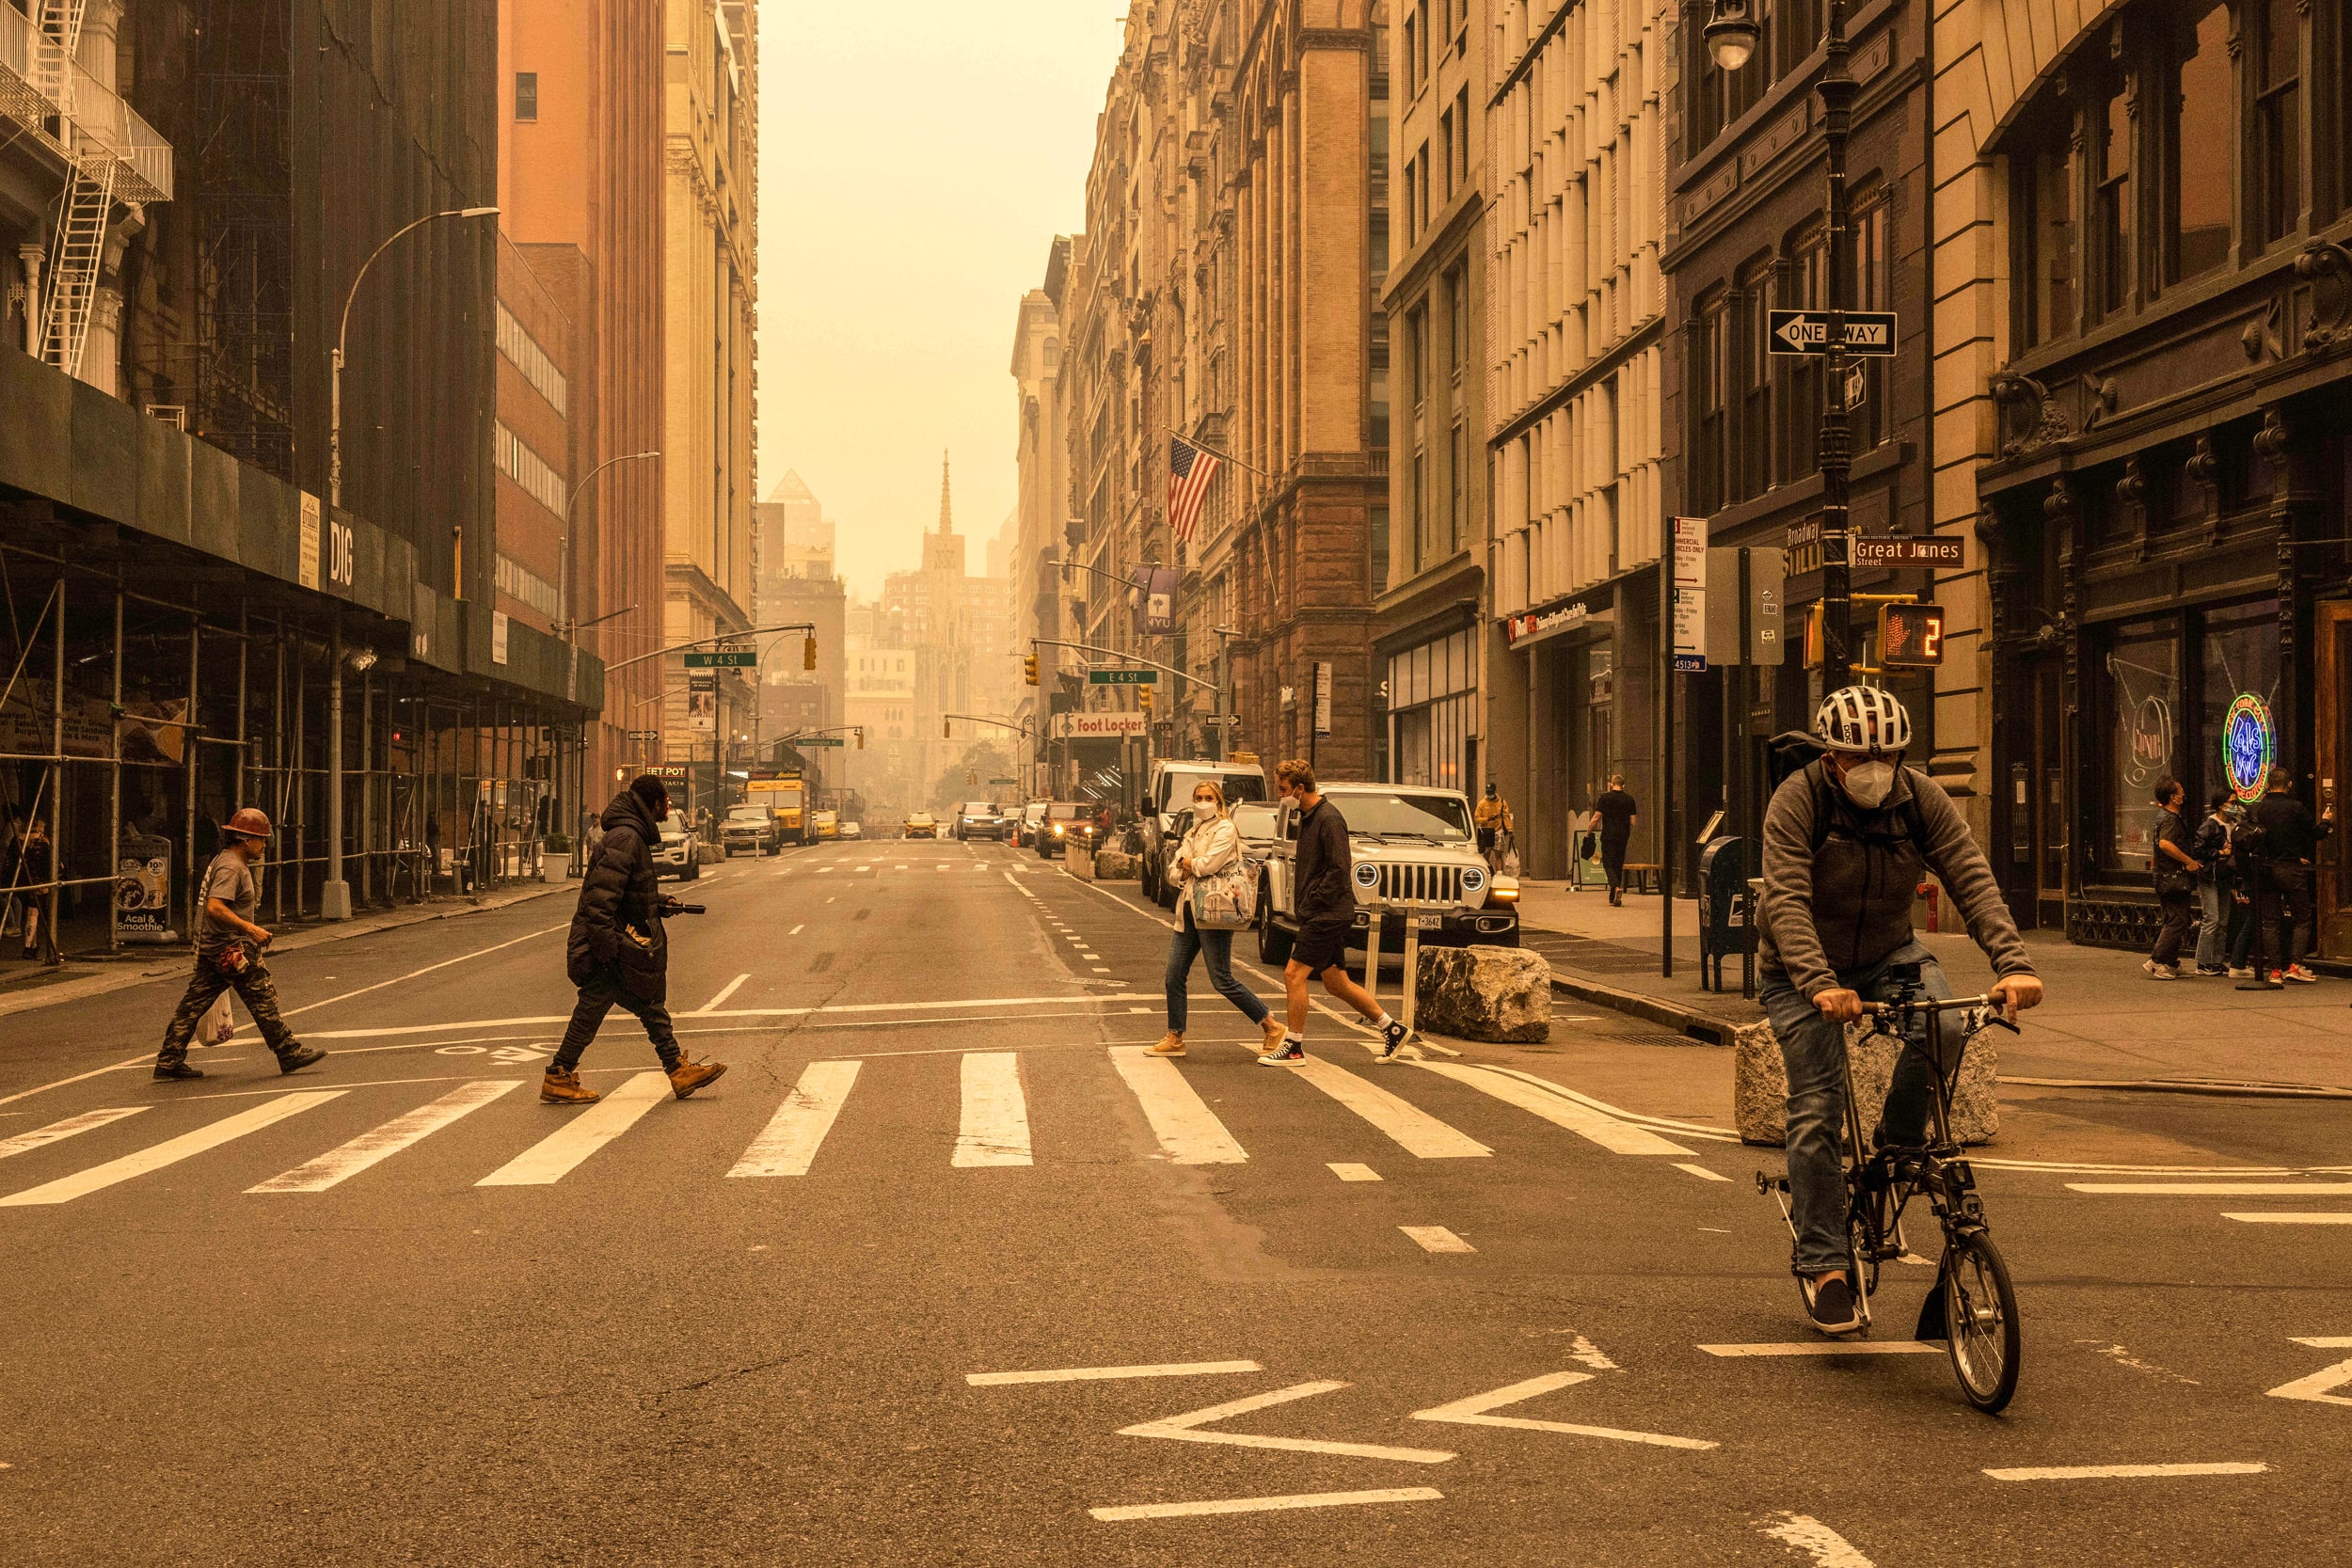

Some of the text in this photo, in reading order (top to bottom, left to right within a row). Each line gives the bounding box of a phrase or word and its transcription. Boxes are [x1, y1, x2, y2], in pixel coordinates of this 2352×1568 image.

[1789, 325, 1879, 341] ONE WAY
[1788, 521, 1820, 547] Broadway
[330, 520, 353, 586] DIG
[1857, 543, 1959, 558] Great Jnes
[1148, 618, 1170, 628] NYU
[1925, 619, 1940, 656] 2
[703, 655, 739, 665] W 4 St
[1109, 673, 1137, 682] E 4 St
[1078, 717, 1142, 732] Foot Locker
[665, 768, 686, 776] POT
[124, 914, 155, 923] Acai &
[117, 922, 164, 931] Smoothie
